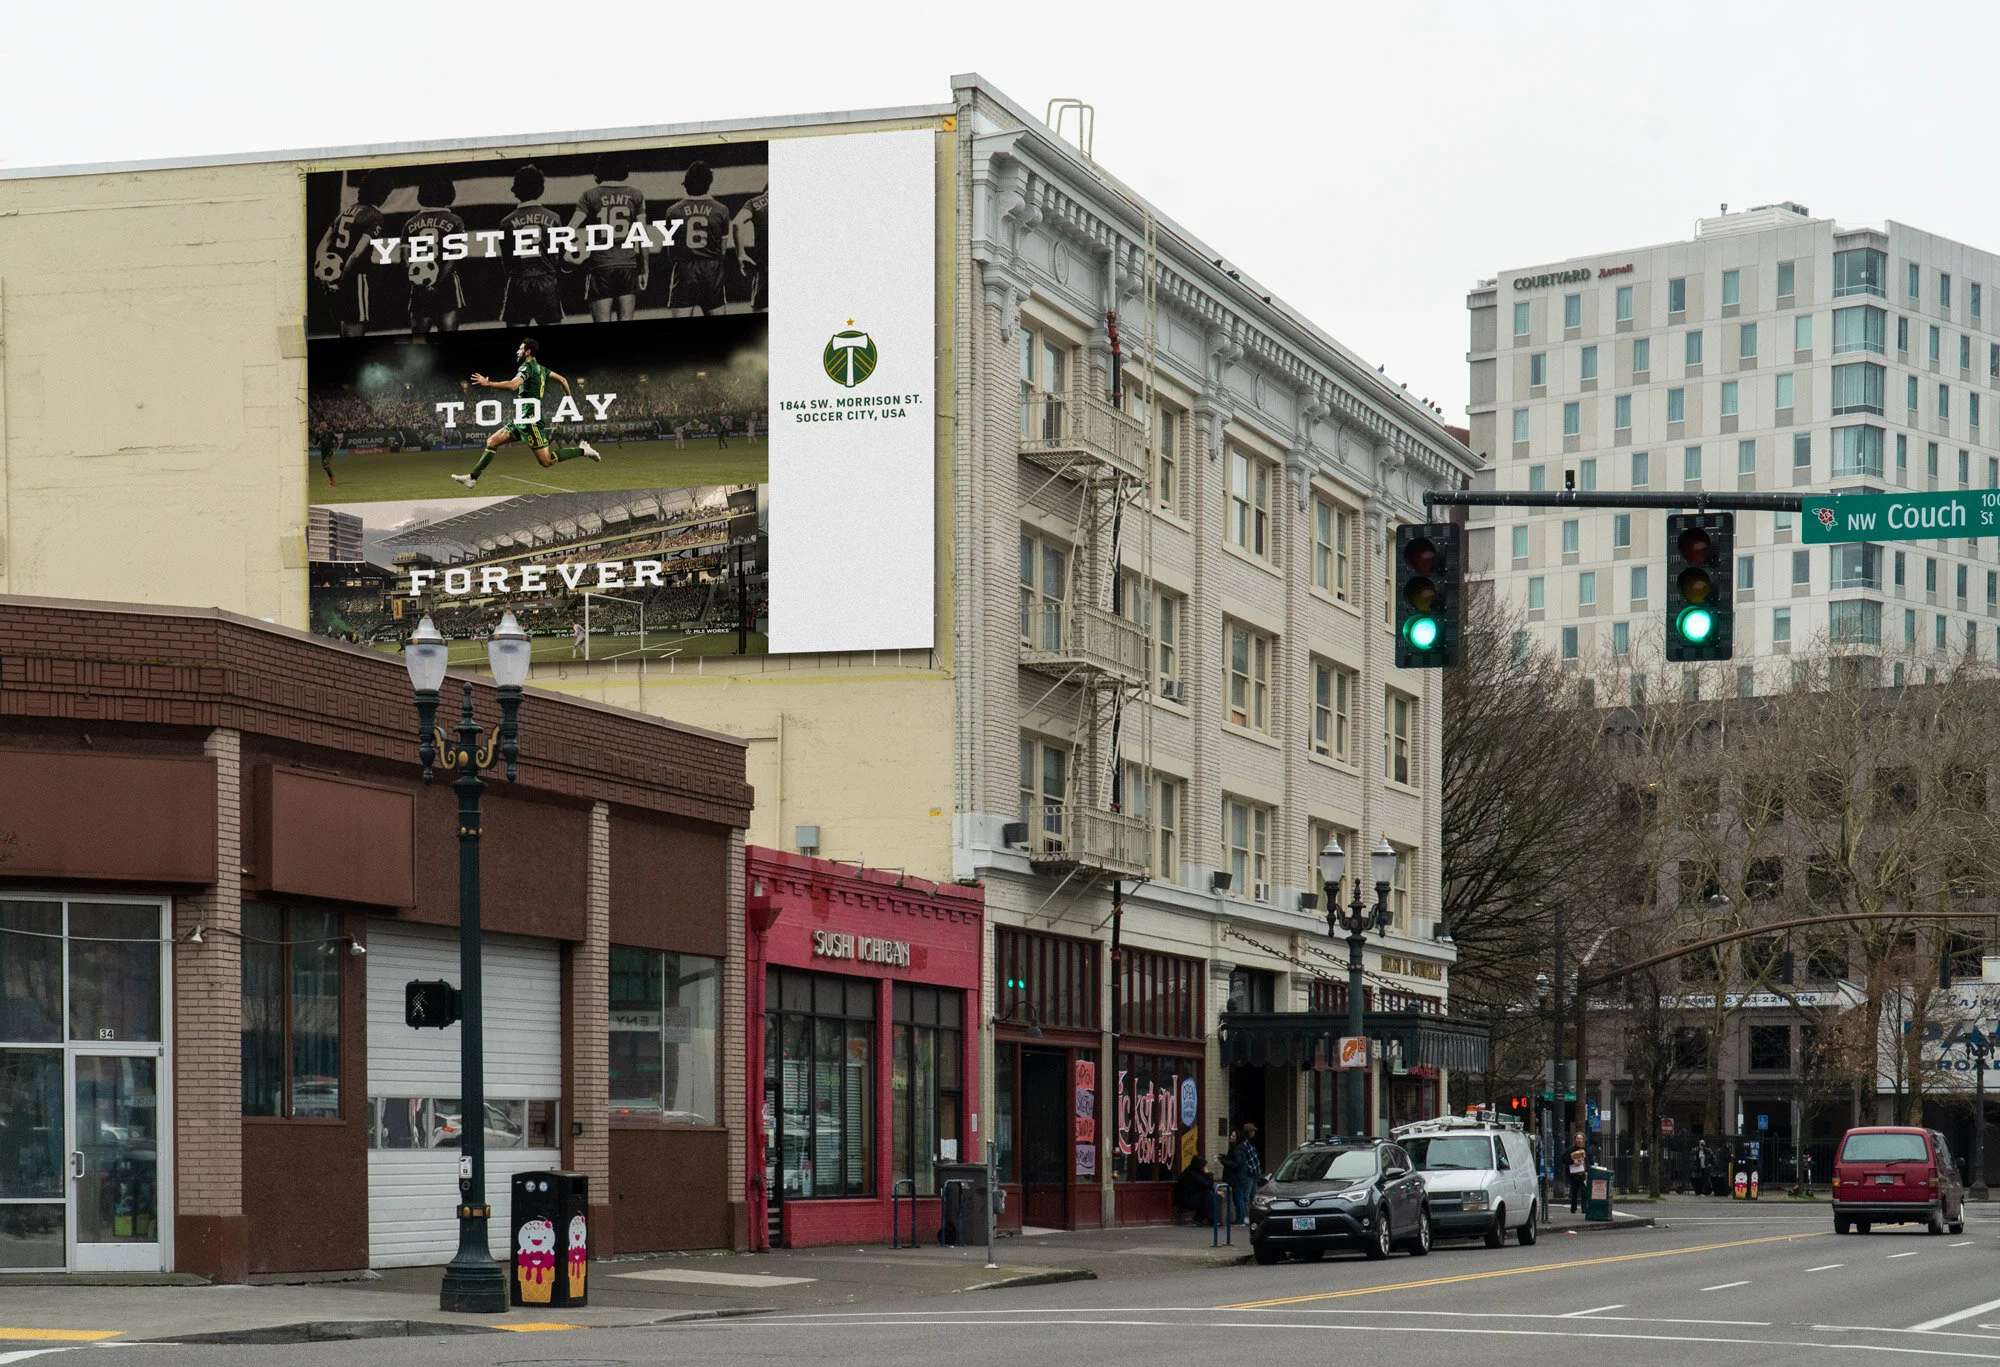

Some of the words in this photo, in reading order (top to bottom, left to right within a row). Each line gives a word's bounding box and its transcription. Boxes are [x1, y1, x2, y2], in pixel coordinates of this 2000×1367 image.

[601, 194, 631, 206] GANT
[684, 204, 712, 217] BAIN
[336, 216, 355, 249] 5
[408, 217, 454, 234] CHARLES
[597, 206, 630, 238] 16
[686, 216, 708, 249] 6
[370, 219, 684, 265] YESTERDAY
[1513, 267, 1591, 291] COURTYARD
[435, 393, 618, 429] TODAY
[779, 400, 807, 411] 1844
[810, 399, 832, 410] SW.
[836, 394, 901, 408] MORRISON
[904, 394, 923, 405] ST.
[796, 411, 843, 423] SOCCER
[847, 410, 878, 421] CITY,
[881, 408, 906, 419] USA
[1847, 513, 1876, 531] NW
[1888, 499, 1966, 530] Couch
[1980, 511, 1994, 525] St
[409, 560, 665, 597] FOREVER
[813, 929, 855, 960] SUSHI
[858, 935, 910, 968] ICHIBAN
[100, 1028, 114, 1039] 34
[1183, 1084, 1196, 1101] OPEN
